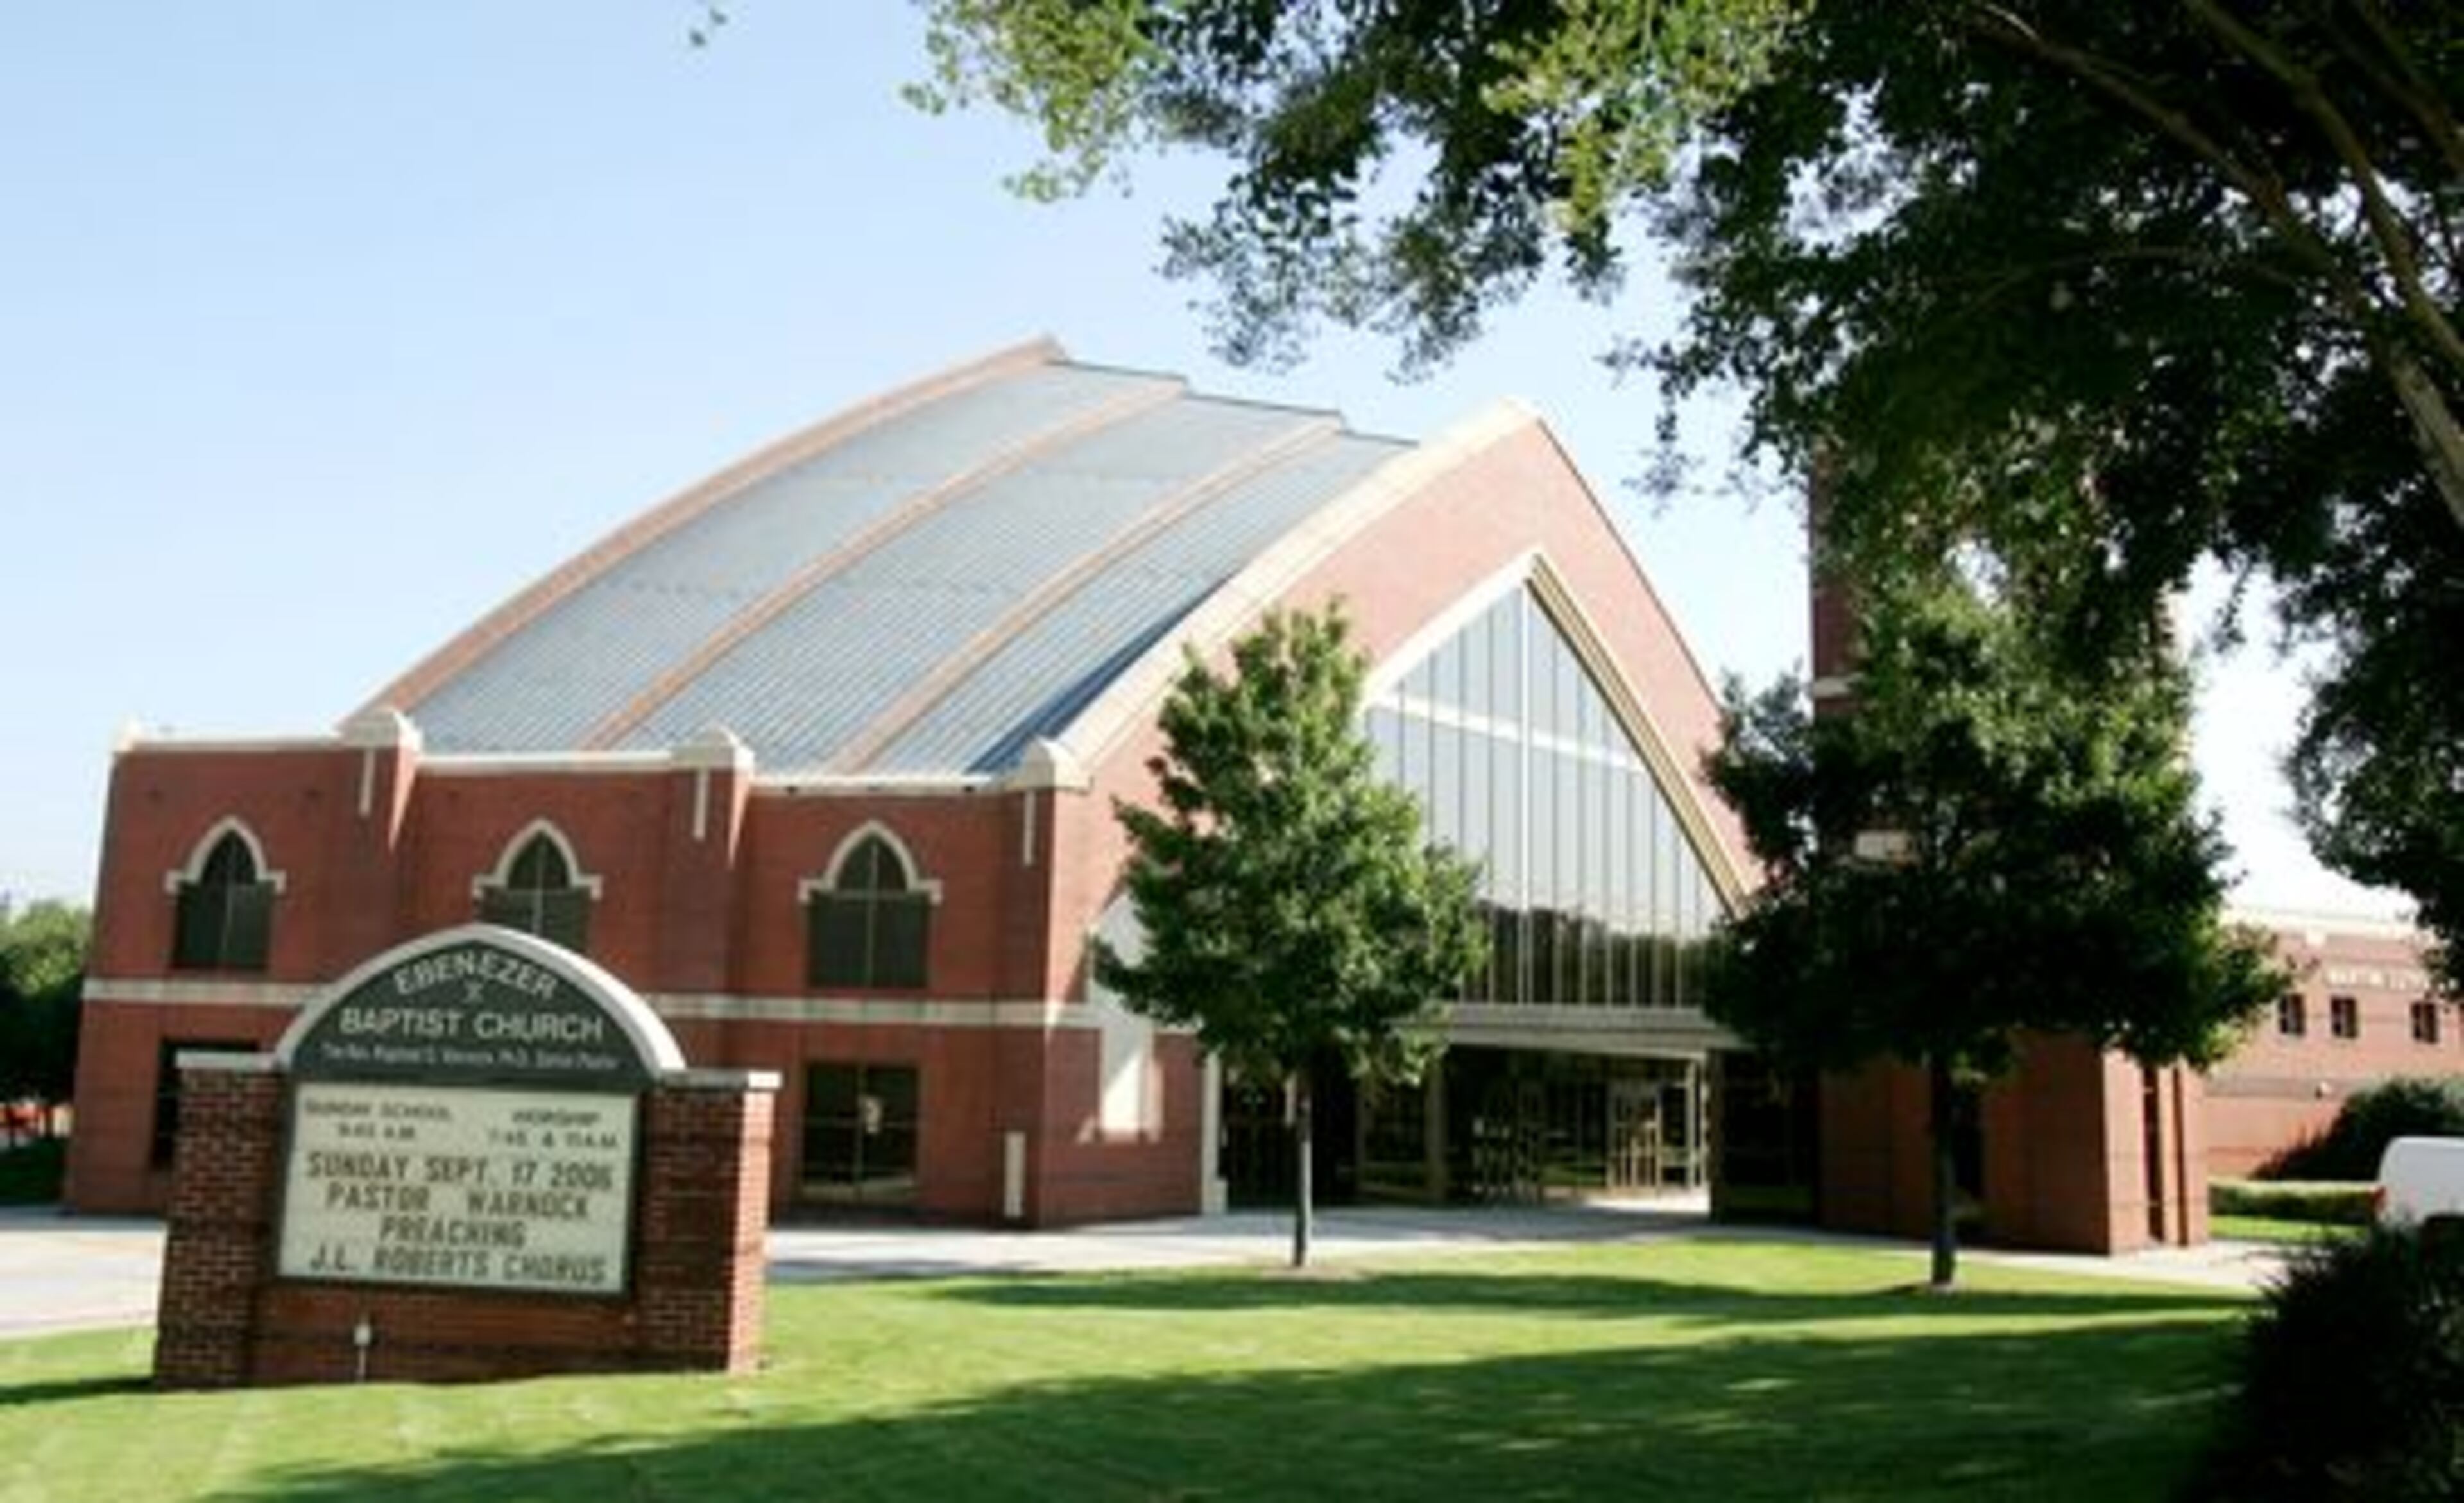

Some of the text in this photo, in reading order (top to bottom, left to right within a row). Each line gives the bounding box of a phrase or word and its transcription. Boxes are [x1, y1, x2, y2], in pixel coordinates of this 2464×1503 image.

[393, 950, 558, 1000] EBENEZER
[340, 1008, 603, 1042] BAPTIST CHURCH
[305, 1097, 372, 1117] SUNDAY
[307, 1152, 409, 1178] SUNDAY
[512, 1162, 538, 1186] 17
[325, 1181, 588, 1218] PASTOR WARNOCK
[379, 1216, 527, 1248] PREACHING
[373, 1246, 490, 1278] ROBERTS
[502, 1255, 607, 1284] CHORUS
